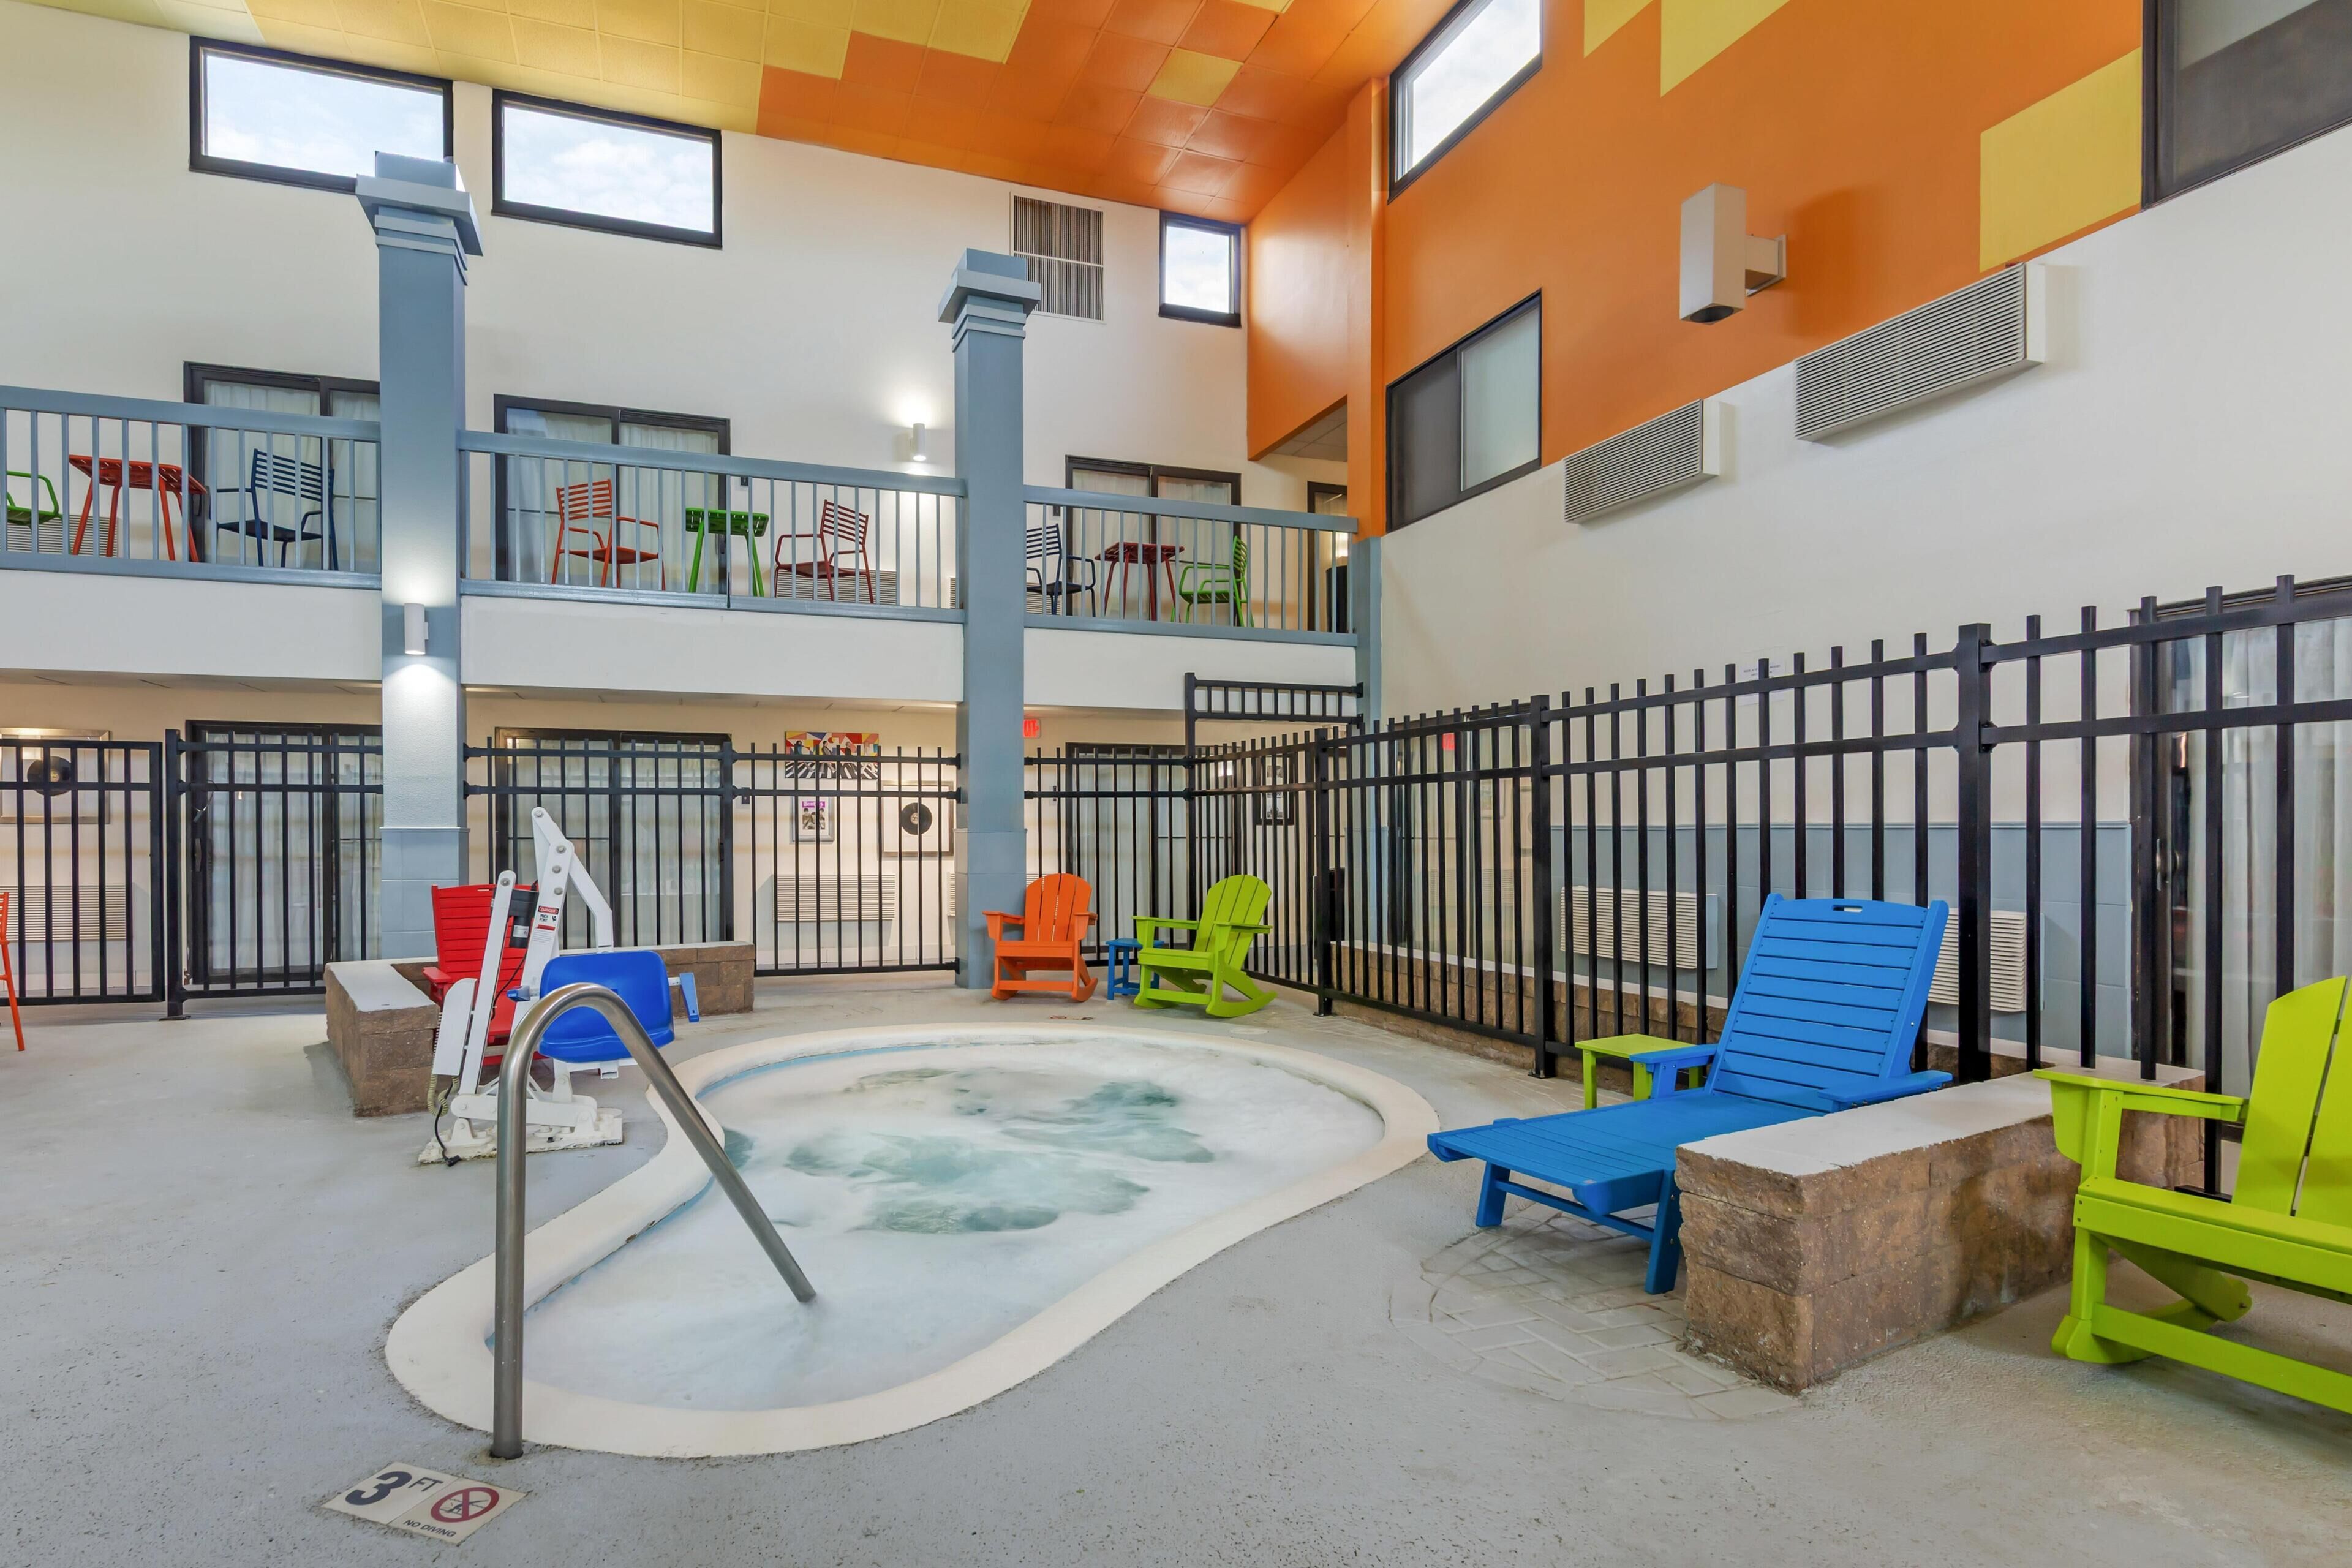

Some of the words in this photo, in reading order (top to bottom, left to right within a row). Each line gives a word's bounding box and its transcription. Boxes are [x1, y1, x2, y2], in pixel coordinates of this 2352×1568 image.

[345, 1471, 413, 1506] 3
[408, 1477, 444, 1492] FT
[402, 1519, 421, 1528] NO
[420, 1524, 456, 1537] DIVING
